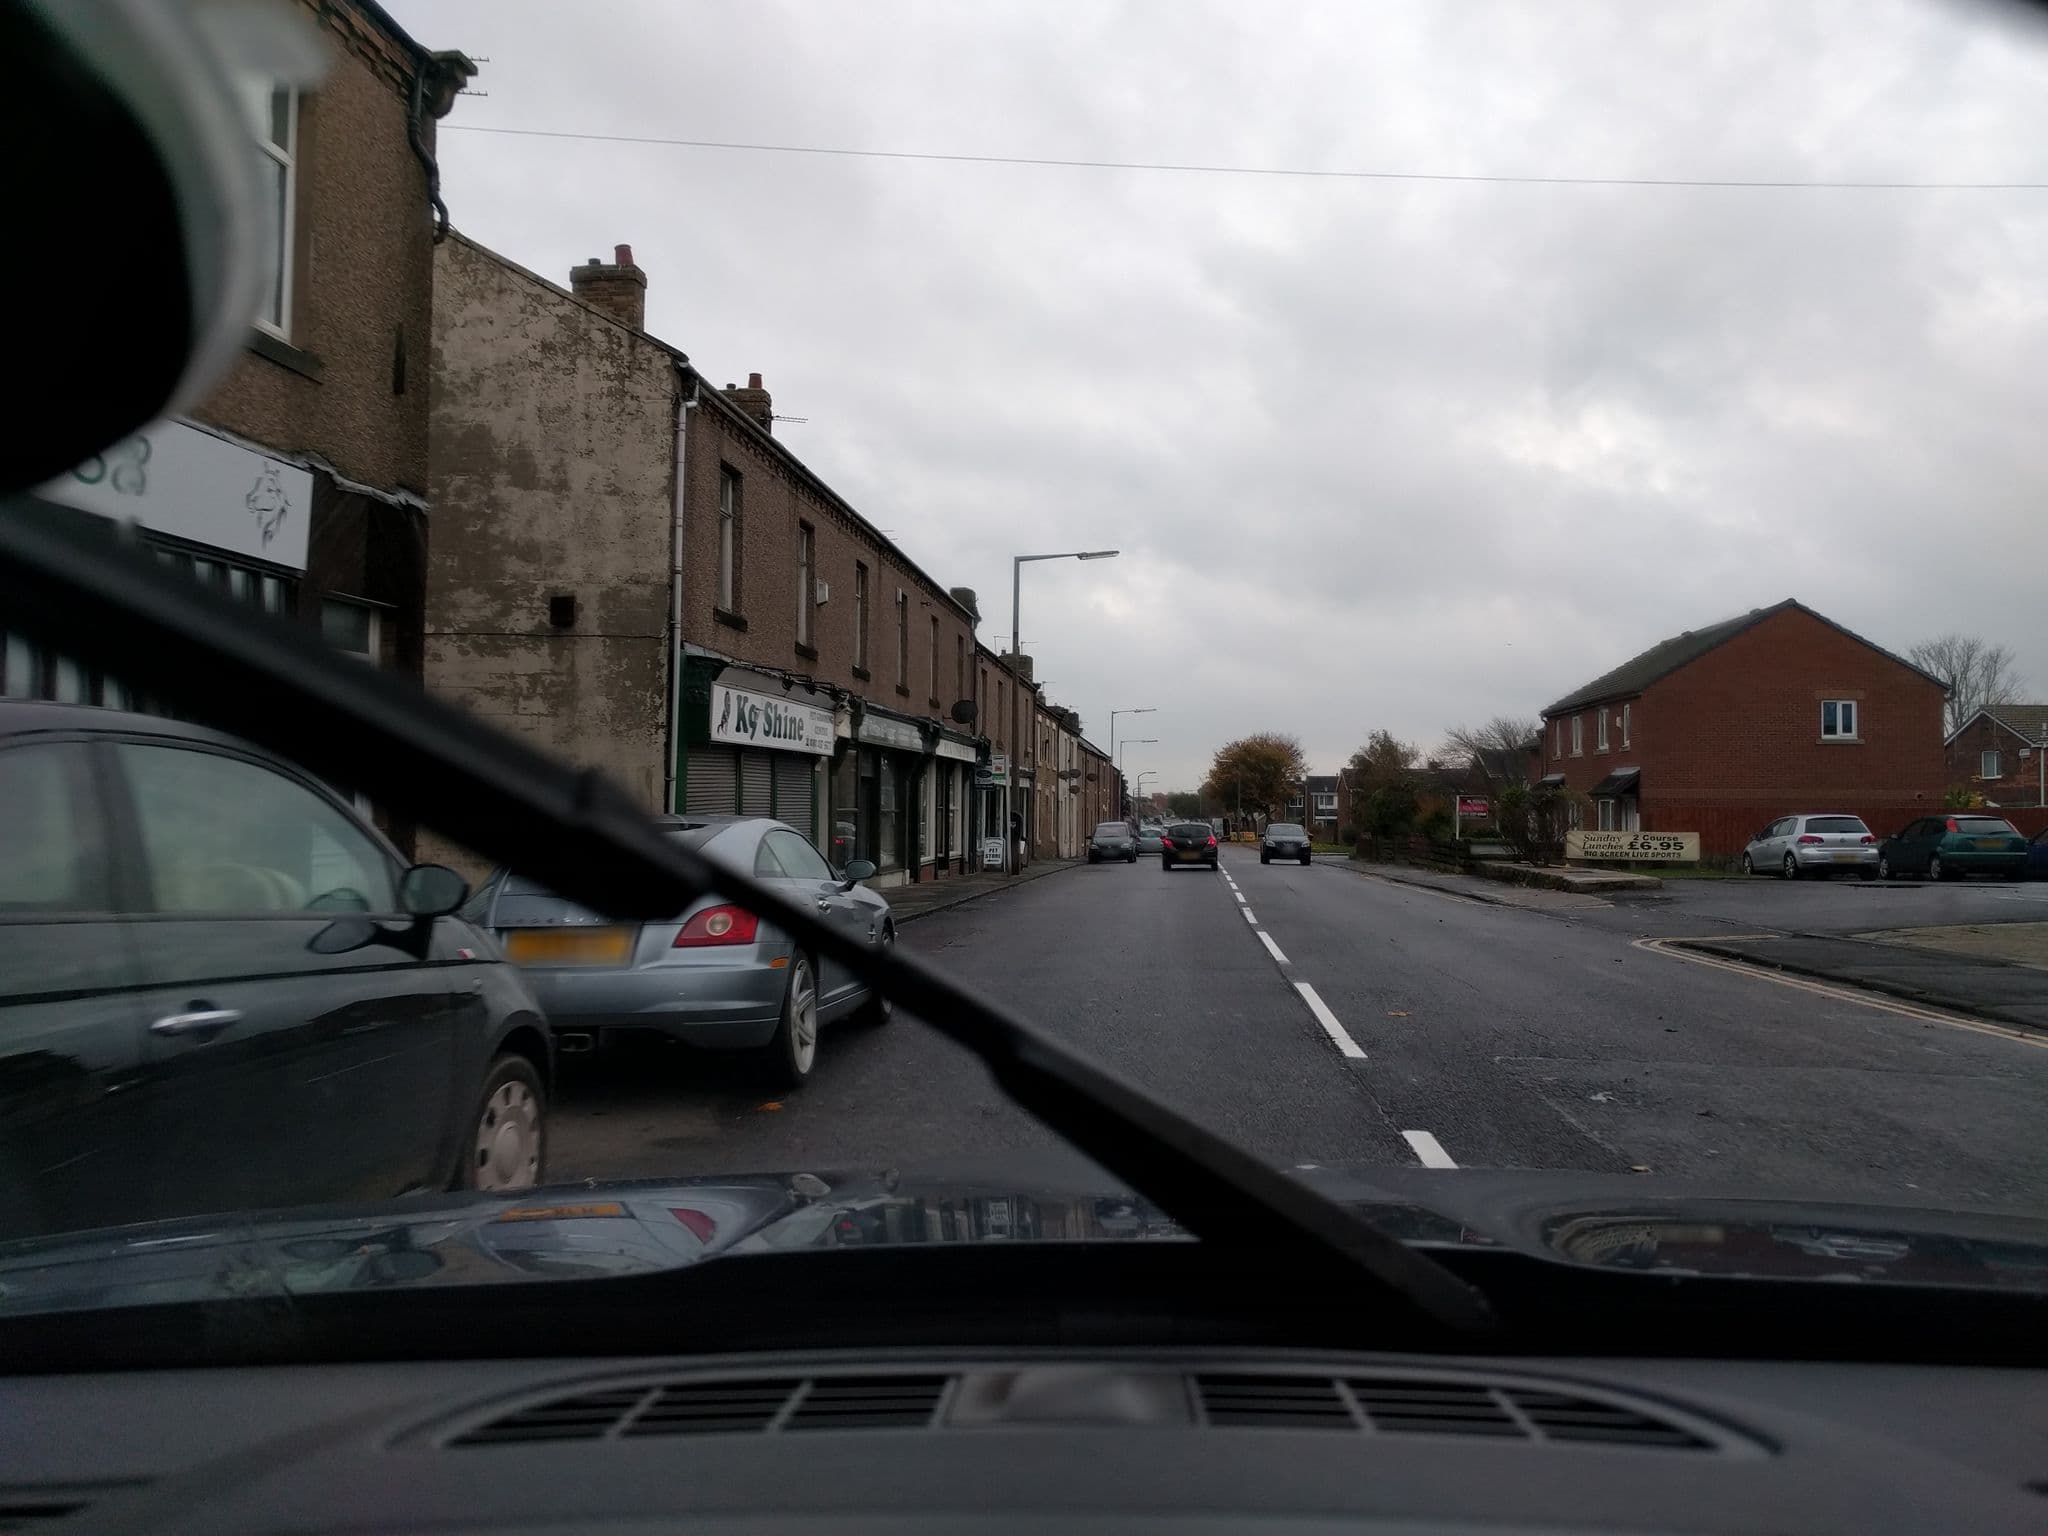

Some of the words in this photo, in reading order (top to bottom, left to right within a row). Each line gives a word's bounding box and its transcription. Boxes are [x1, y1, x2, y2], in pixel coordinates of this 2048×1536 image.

[763, 701, 804, 741] Shine
[1583, 834, 1622, 843] Sunday
[1582, 842, 1623, 850] Lunches
[1627, 841, 1684, 850] £6.95
[1651, 851, 1682, 859] SPORTS
